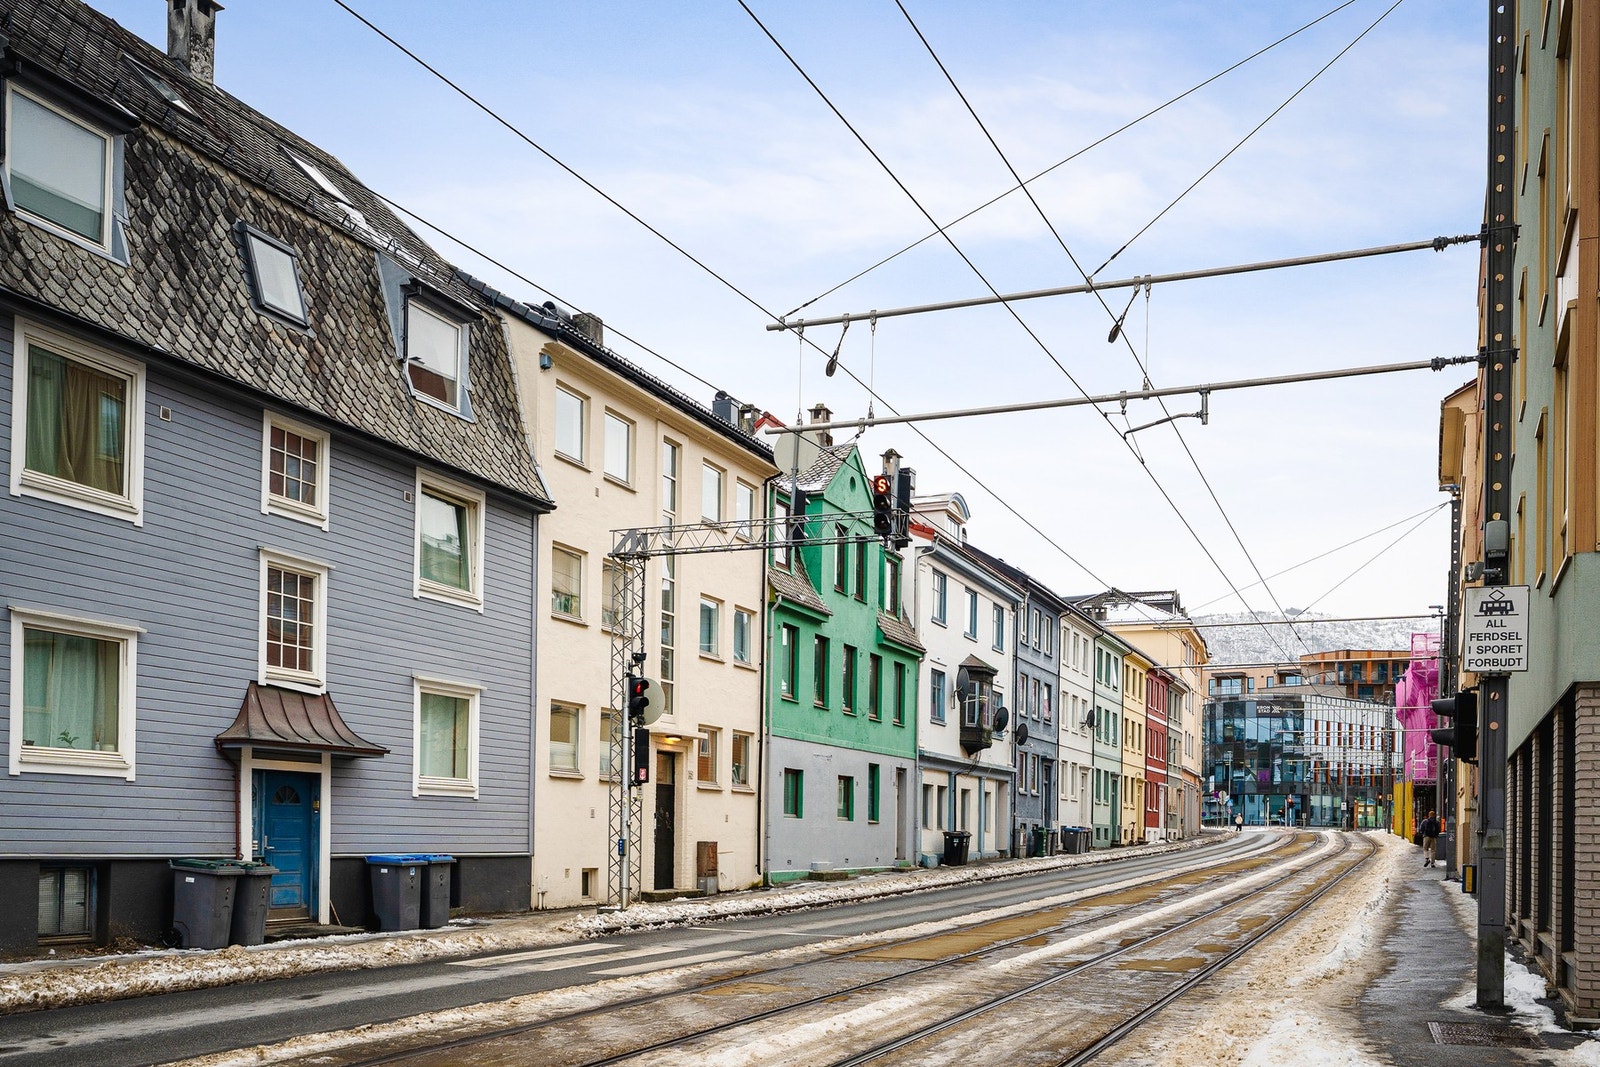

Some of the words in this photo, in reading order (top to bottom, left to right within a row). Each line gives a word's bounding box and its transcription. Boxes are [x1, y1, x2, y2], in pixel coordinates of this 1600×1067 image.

[1485, 620, 1506, 628] ALL
[1470, 632, 1522, 641] FERDSEL
[1476, 645, 1522, 654] SPORET
[1468, 658, 1522, 667] FORBUDT
